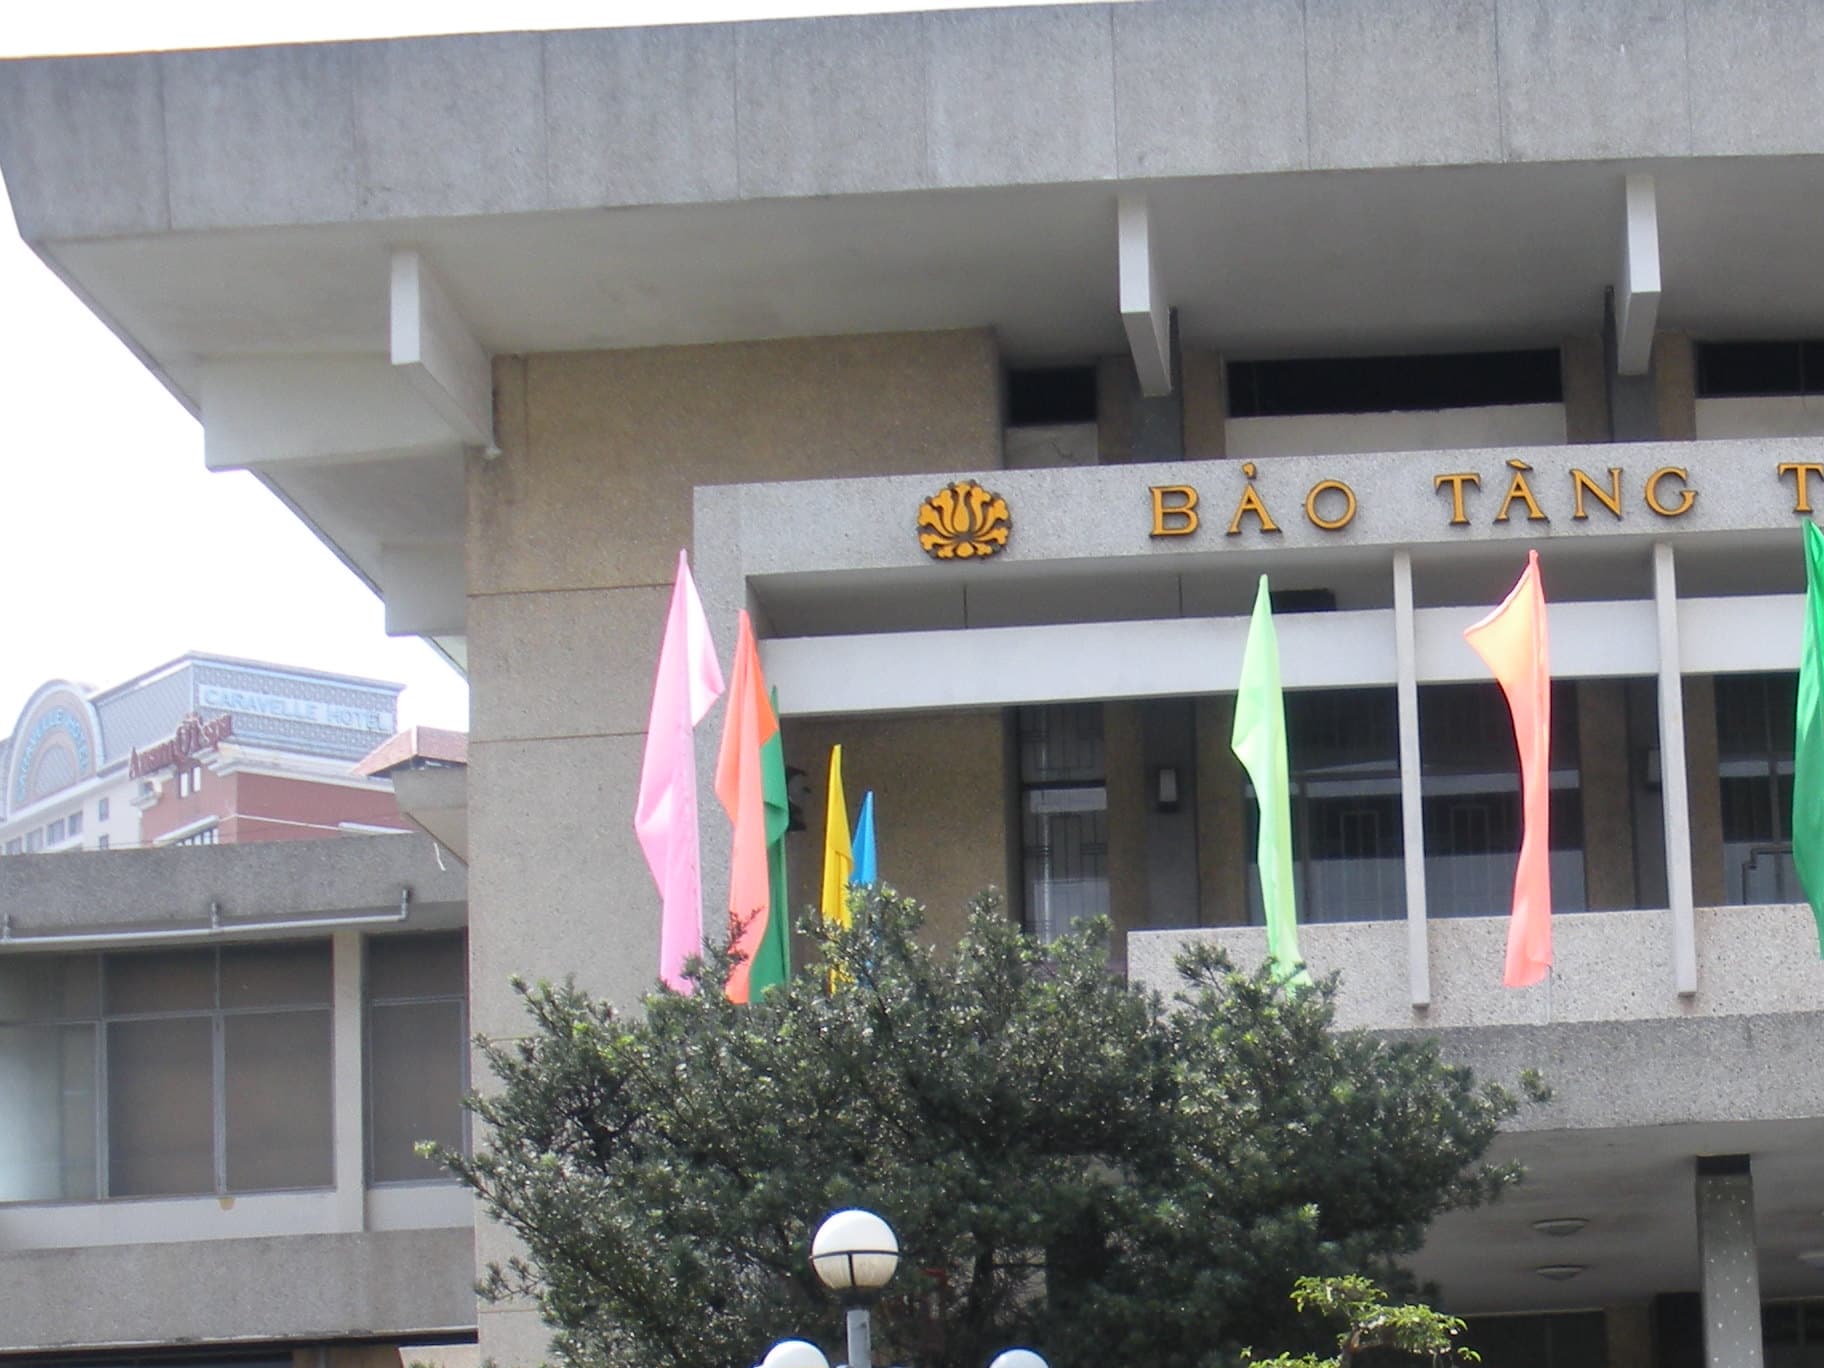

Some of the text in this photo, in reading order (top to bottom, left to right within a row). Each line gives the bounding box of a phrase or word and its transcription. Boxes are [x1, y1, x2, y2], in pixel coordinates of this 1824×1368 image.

[1149, 463, 1358, 538] BẢO
[1433, 459, 1699, 524] TÀNG
[203, 689, 389, 731] CARAVELLE HOTEL
